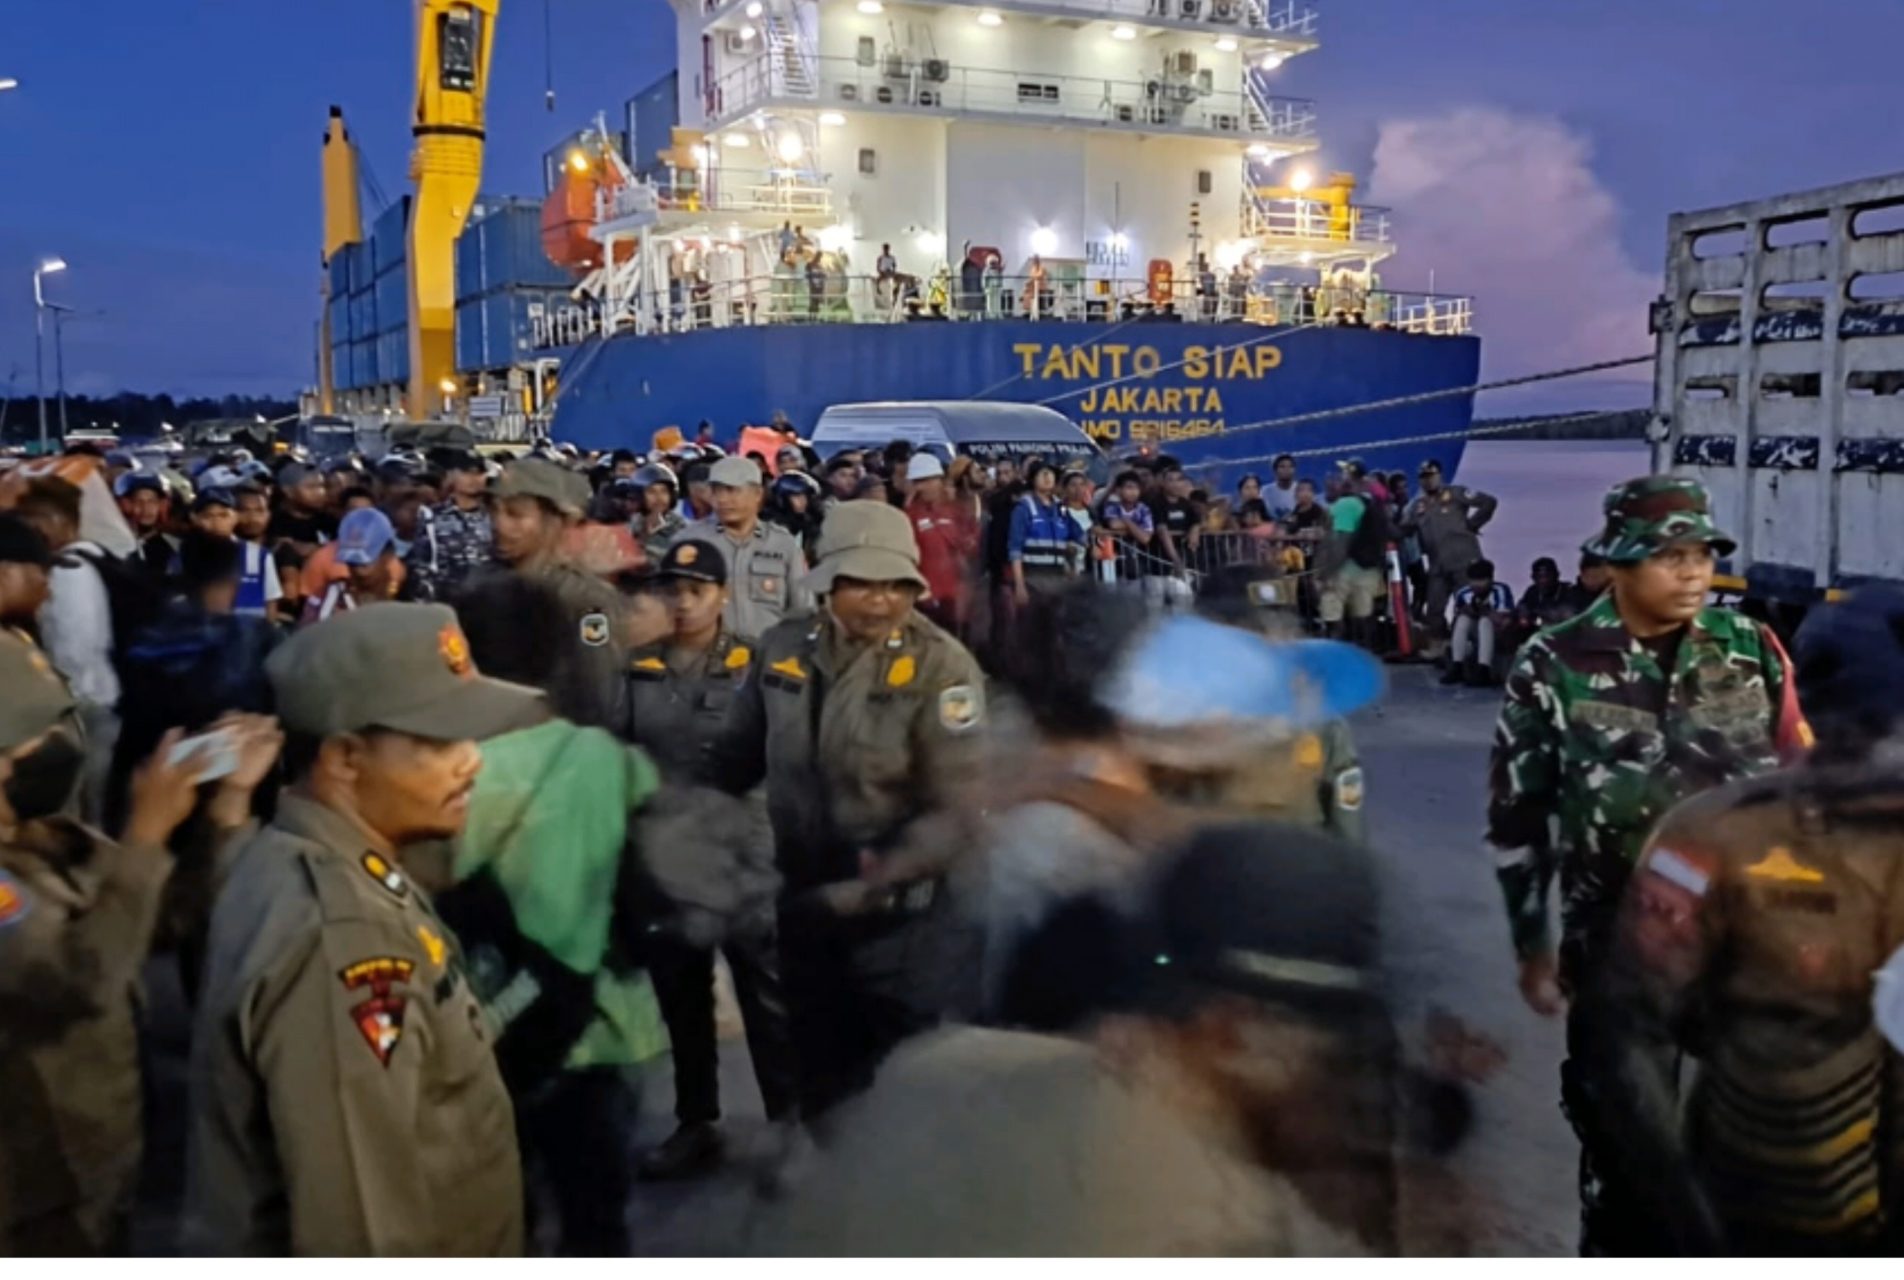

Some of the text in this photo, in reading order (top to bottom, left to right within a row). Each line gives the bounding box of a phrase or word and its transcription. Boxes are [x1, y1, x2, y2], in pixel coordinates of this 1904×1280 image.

[1012, 343, 1282, 379] TANTO SIAP
[1080, 386, 1223, 413] JAKARTA
[1081, 418, 1121, 439] IMO
